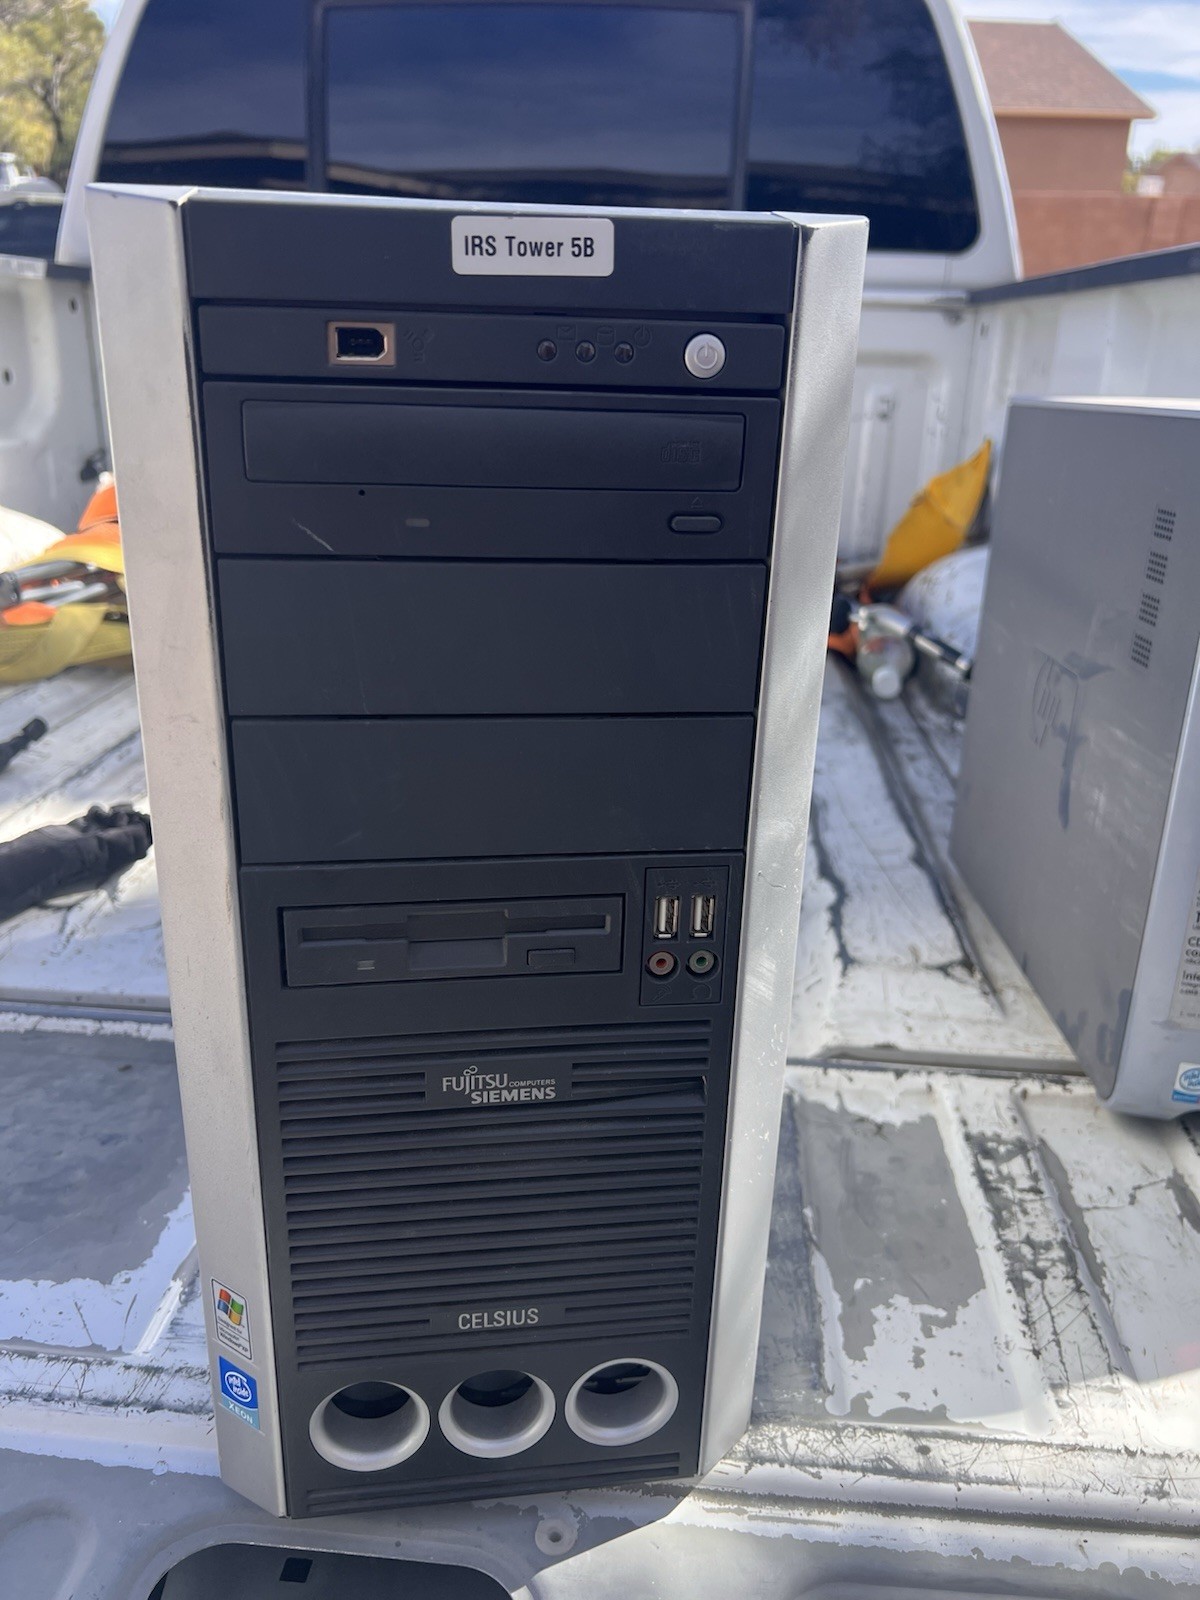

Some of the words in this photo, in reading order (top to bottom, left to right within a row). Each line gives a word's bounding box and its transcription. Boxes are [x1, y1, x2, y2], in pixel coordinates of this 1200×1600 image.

[464, 235, 497, 257] IRS
[504, 236, 564, 258] Tower
[570, 237, 596, 258] 5B
[442, 1066, 509, 1095] FUJITSU
[509, 1078, 556, 1088] COMPUTERS
[471, 1087, 556, 1105] SIEMENS
[458, 1307, 539, 1330] CELSIUS
[228, 1400, 254, 1425] XEON
